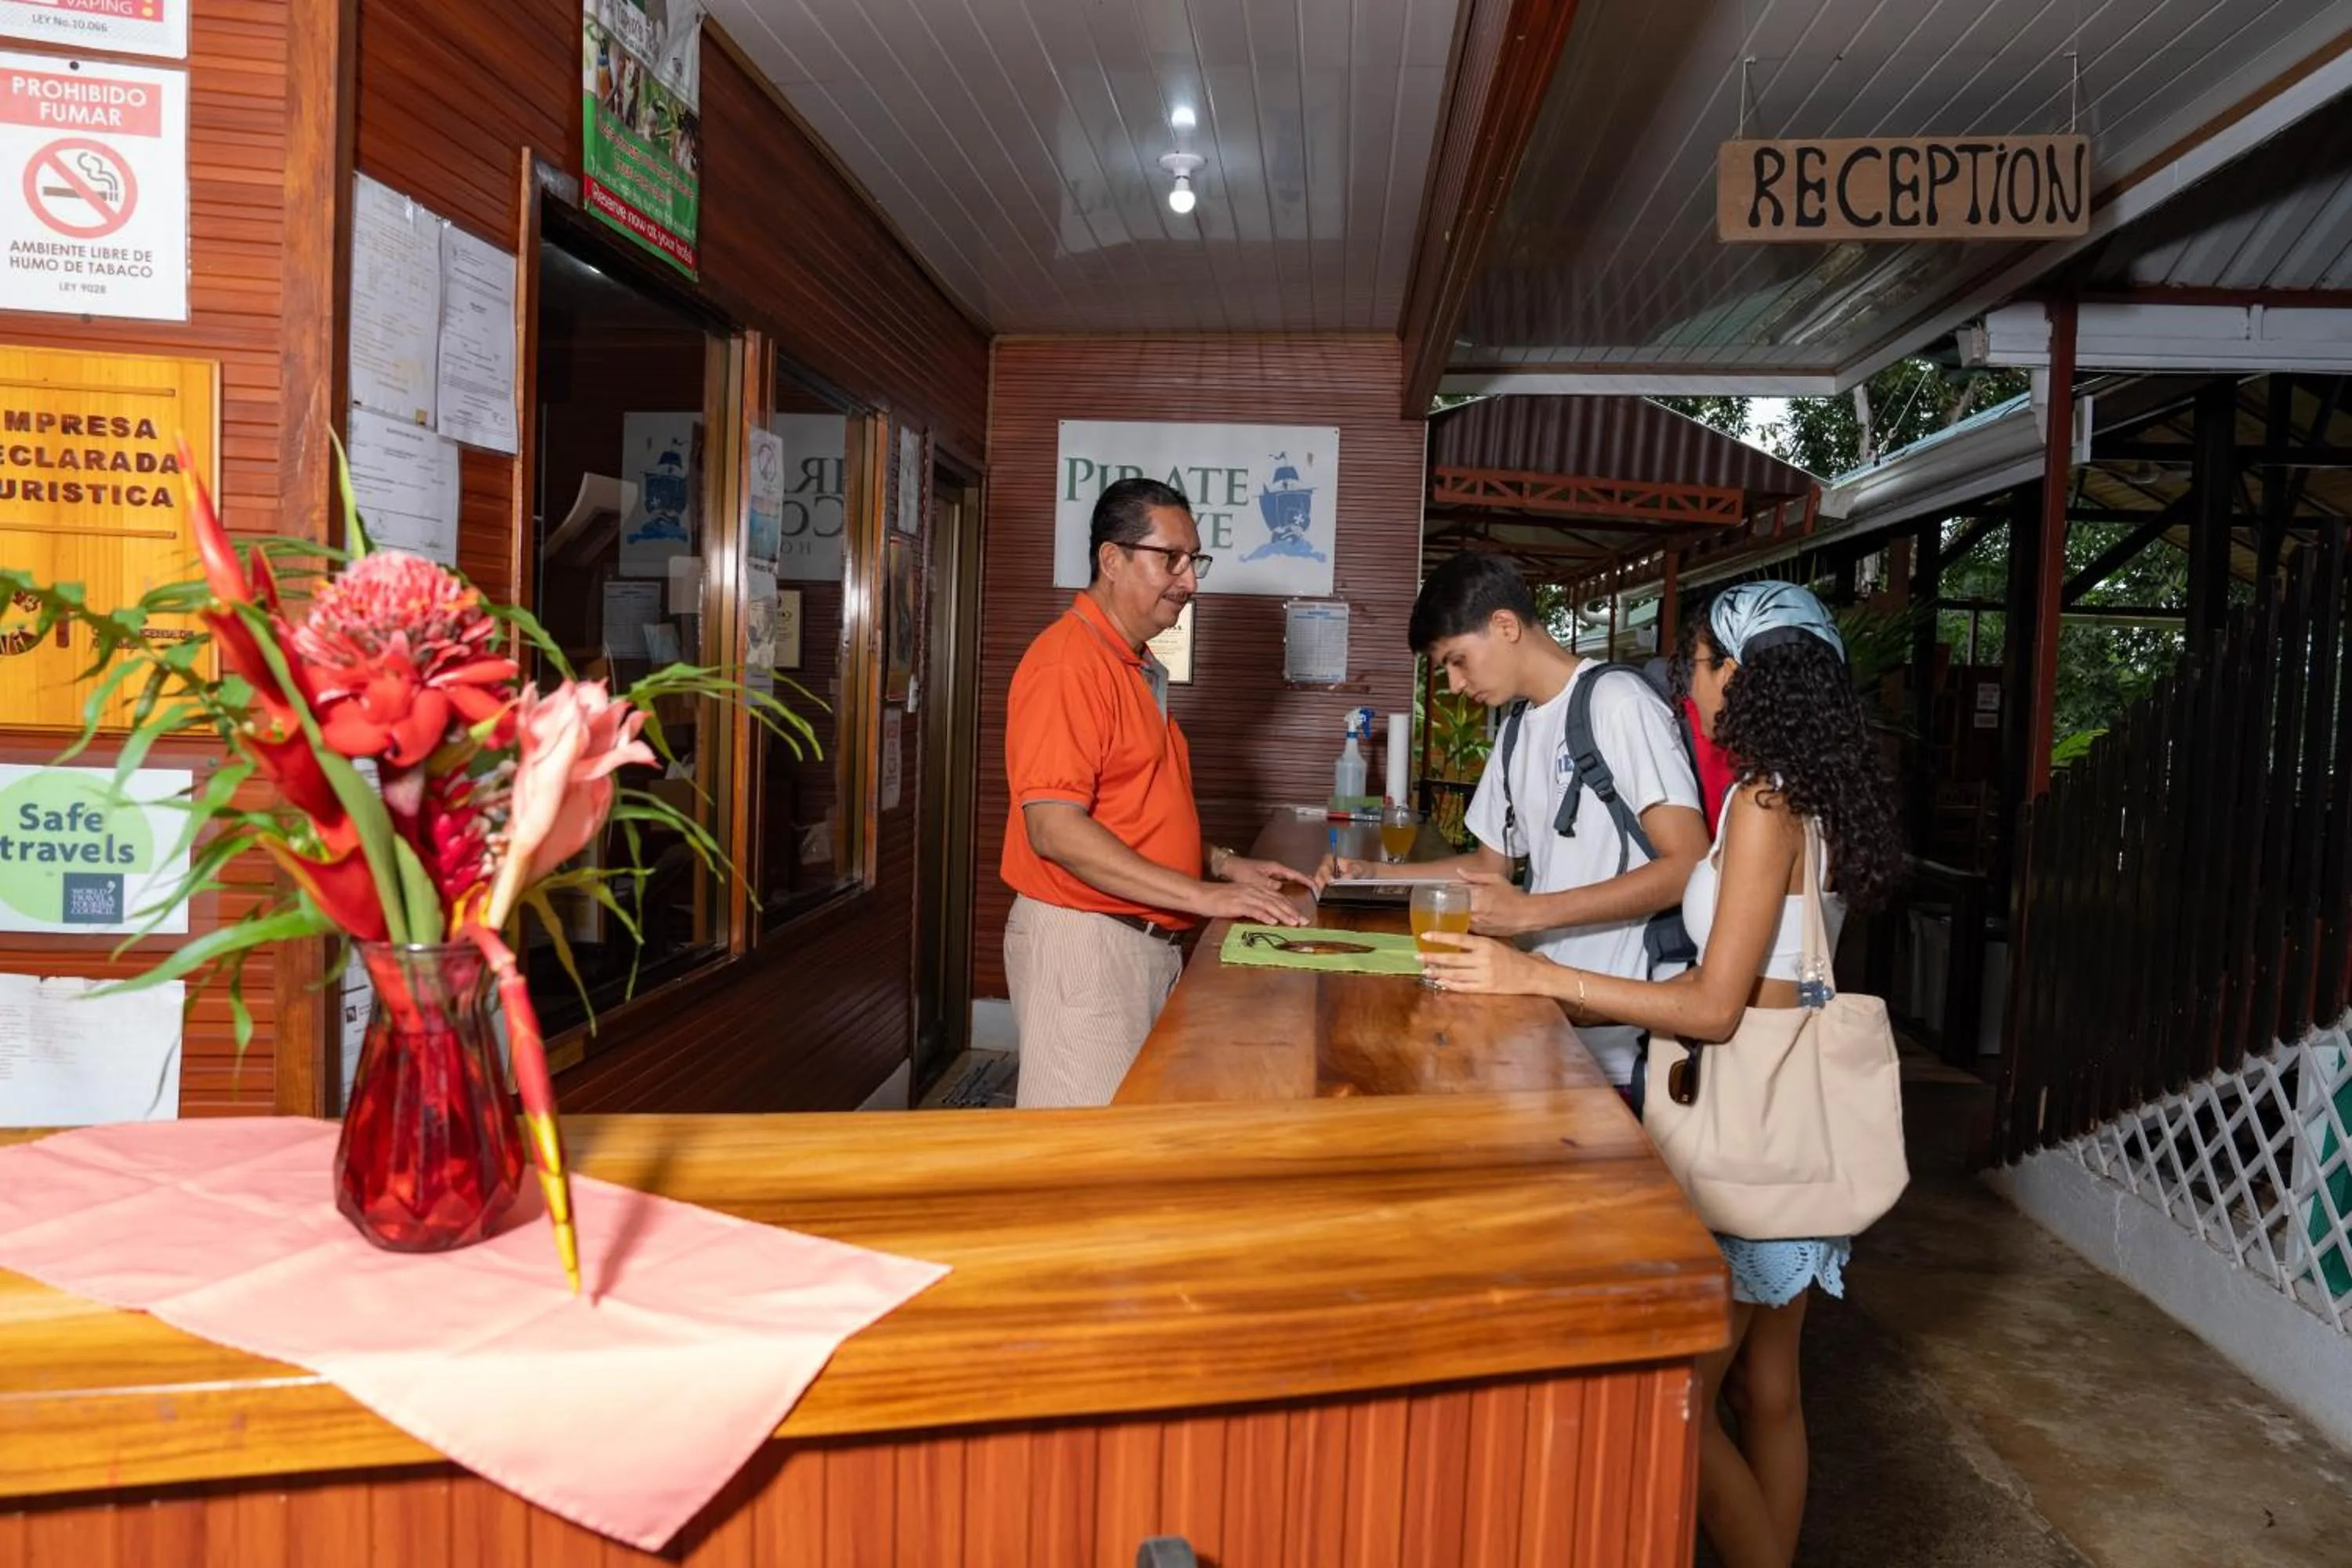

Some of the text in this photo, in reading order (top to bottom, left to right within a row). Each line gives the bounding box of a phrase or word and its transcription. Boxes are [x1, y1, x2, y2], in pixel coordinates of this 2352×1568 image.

[12, 75, 147, 107] PROHIBIDO
[40, 101, 122, 126] FUMAR
[9, 240, 153, 263] AMBIENTE LIBRE DE
[9, 256, 154, 278] HUMO DE TABACO
[59, 281, 77, 292] LEY
[4, 409, 158, 440] MPRESA
[0, 445, 180, 475] CLARADA
[0, 478, 175, 508] URISTICA
[20, 802, 103, 833] Safe
[0, 833, 136, 863] travels
